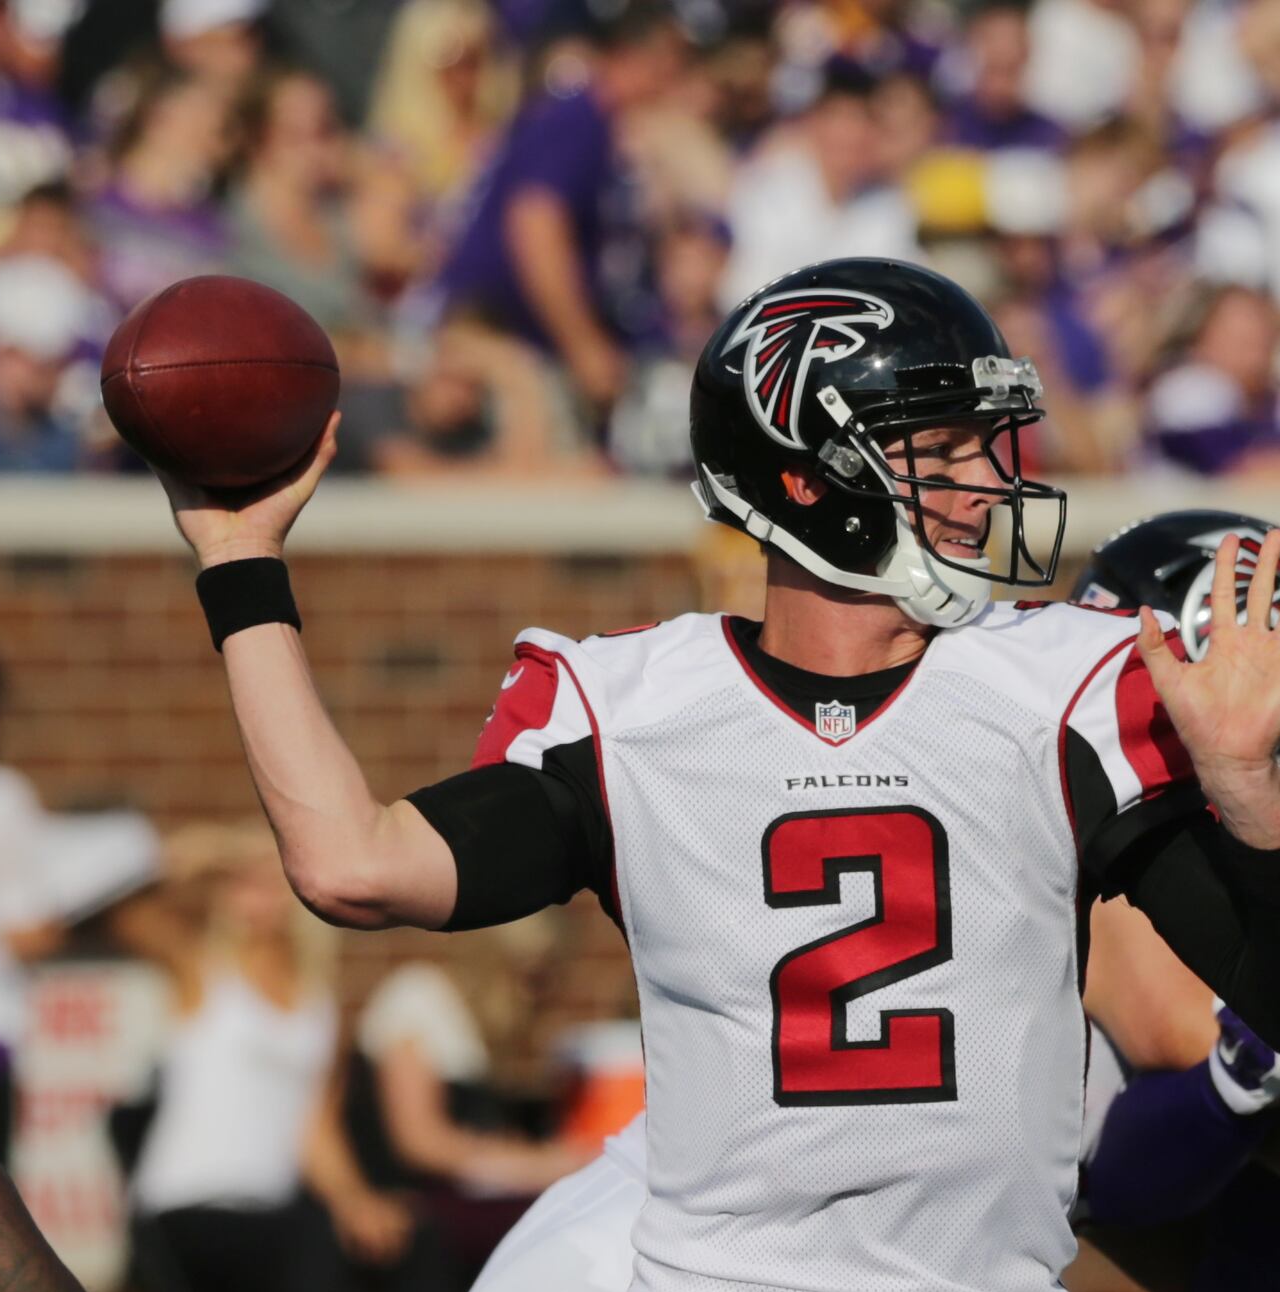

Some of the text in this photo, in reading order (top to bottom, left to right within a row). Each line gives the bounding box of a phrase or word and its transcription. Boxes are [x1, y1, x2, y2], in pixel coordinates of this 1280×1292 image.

[822, 717, 850, 733] NFL
[784, 774, 909, 791] FALCONS
[761, 804, 958, 1108] 2
